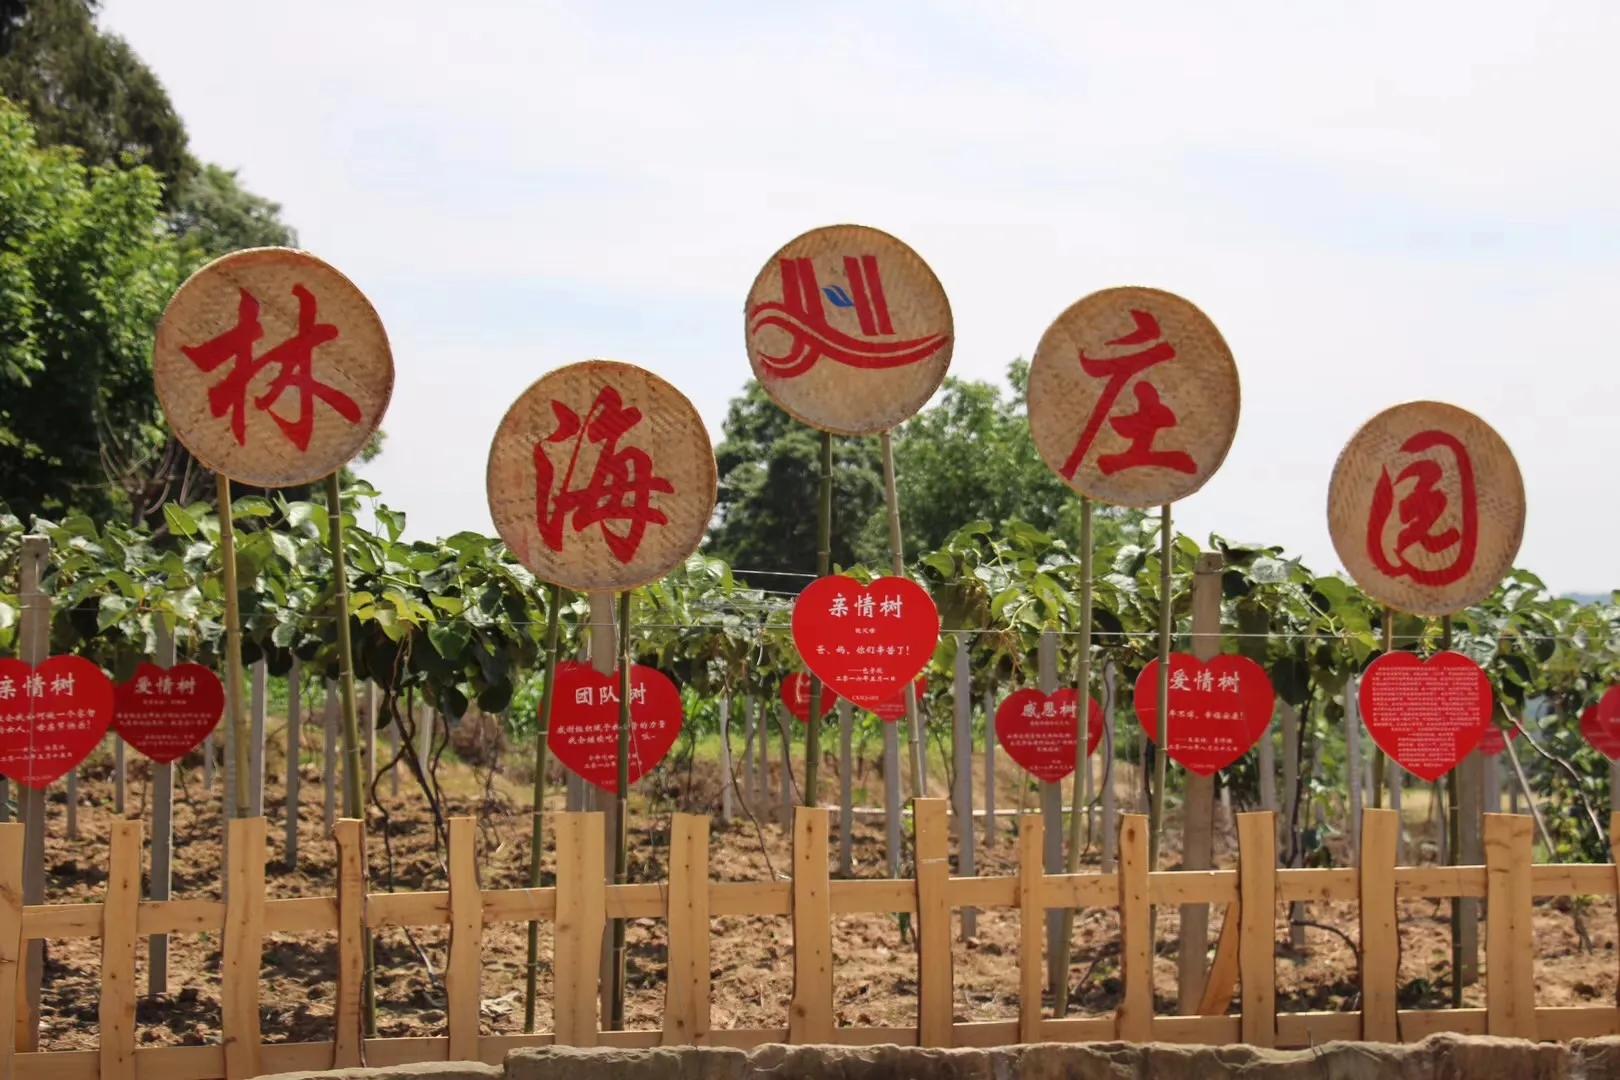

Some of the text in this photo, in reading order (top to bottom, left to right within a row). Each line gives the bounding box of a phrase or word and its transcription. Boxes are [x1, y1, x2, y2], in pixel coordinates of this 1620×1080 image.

[181, 283, 1478, 586] 林 海 庄 园
[828, 592, 903, 618] 亲情树
[1169, 668, 1240, 693] 爱情树
[1021, 700, 1077, 719] 感恩树
